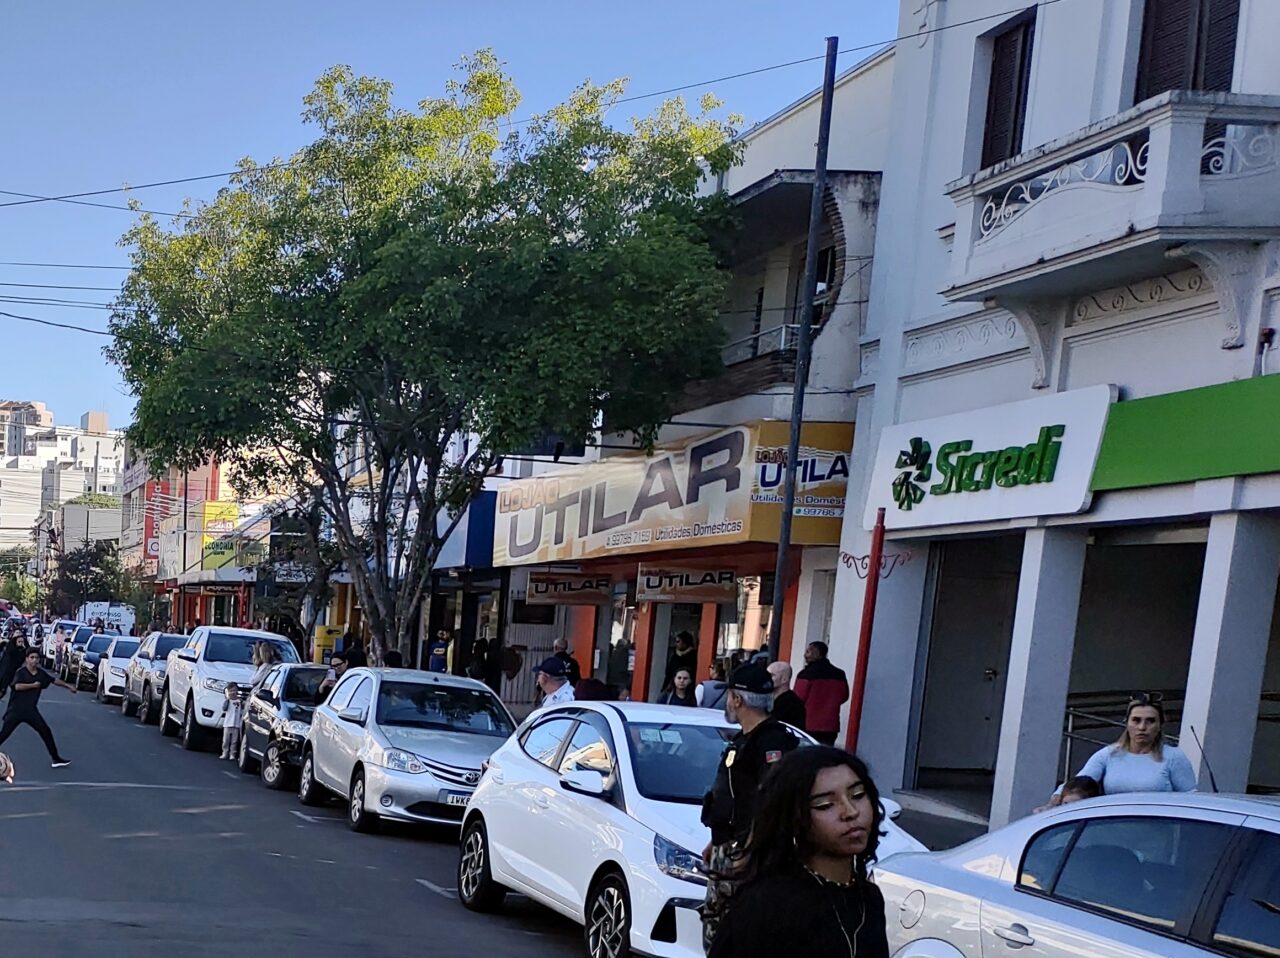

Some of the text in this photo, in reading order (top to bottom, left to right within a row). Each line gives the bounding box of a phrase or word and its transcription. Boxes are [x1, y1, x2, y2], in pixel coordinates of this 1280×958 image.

[930, 424, 1066, 496] Sicredi
[509, 430, 745, 558] UTILAR
[655, 526, 691, 541] Utilidades
[534, 579, 609, 594] UTILAR
[646, 570, 735, 589] UTILAR
